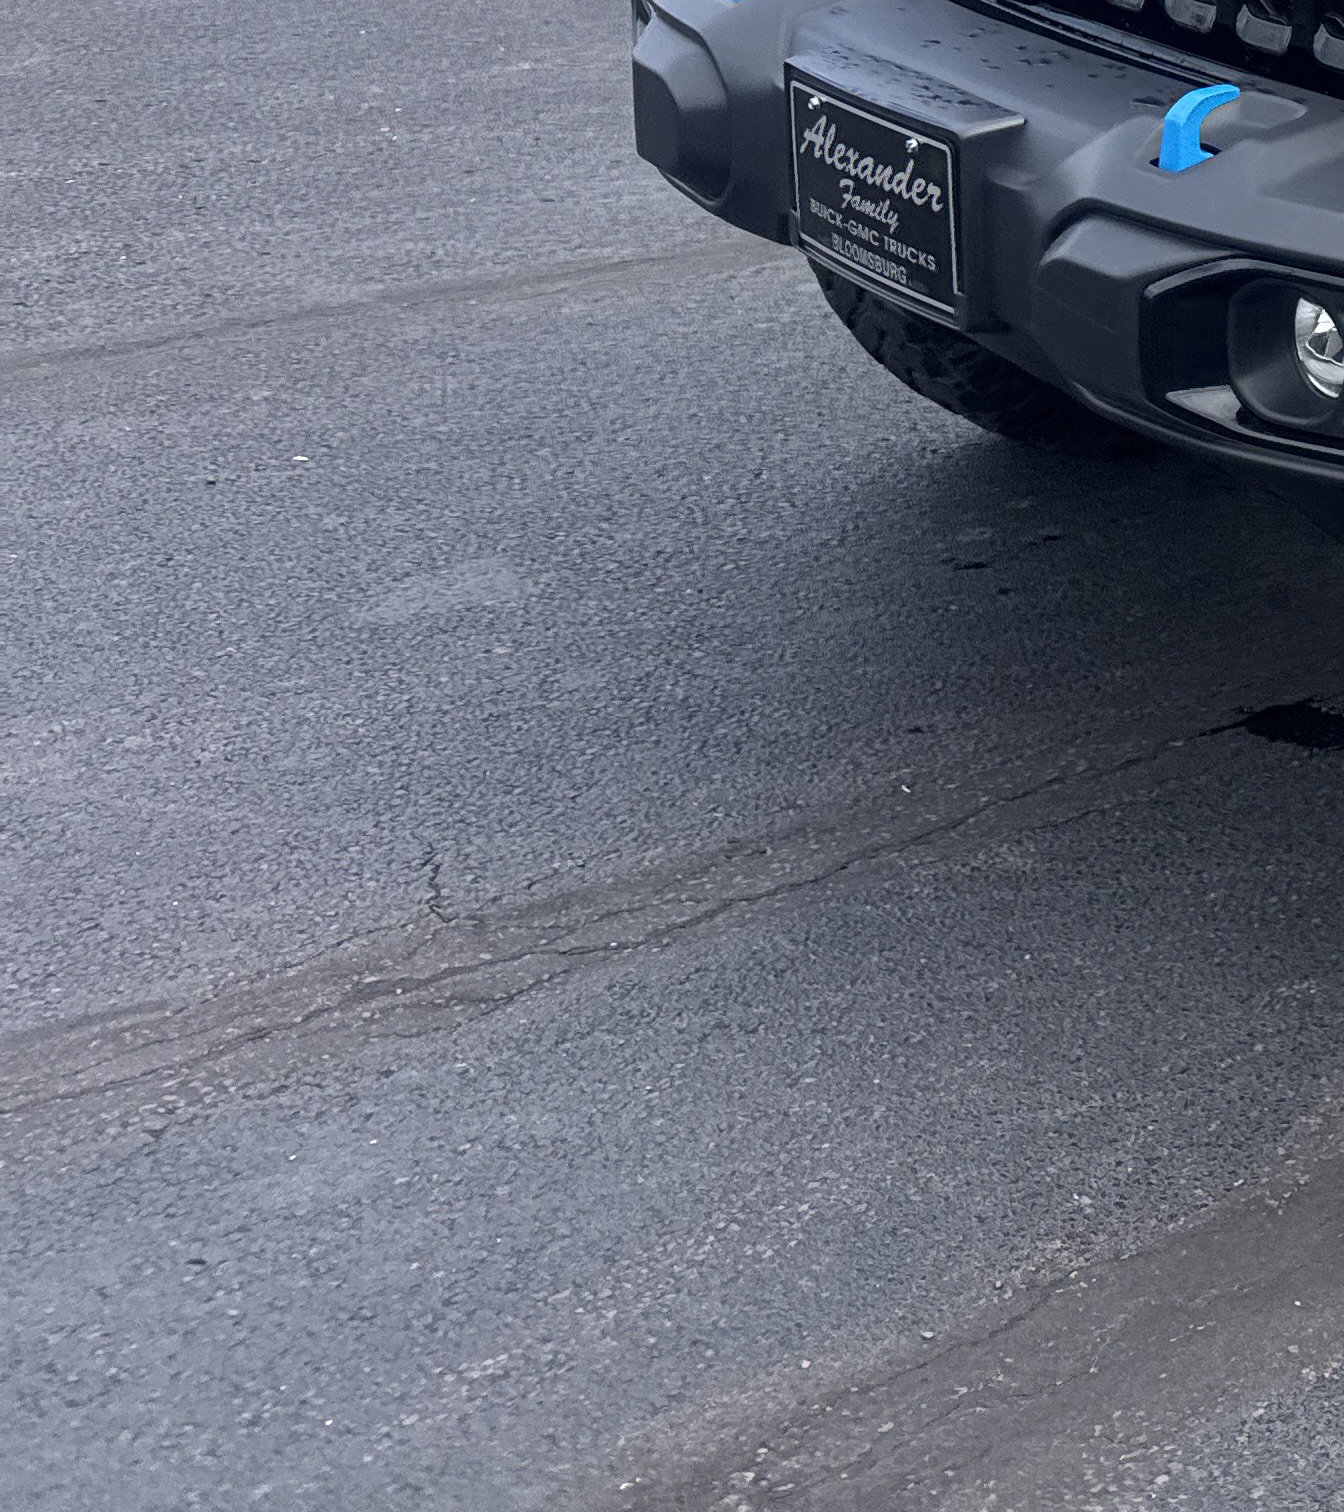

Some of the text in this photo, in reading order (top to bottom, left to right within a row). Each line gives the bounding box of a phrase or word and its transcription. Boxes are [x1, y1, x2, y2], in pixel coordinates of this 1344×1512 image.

[800, 115, 944, 213] Alexander
[839, 178, 900, 235] Family
[831, 232, 907, 285] BLOOMSBURG
[883, 235, 937, 272] TRUCKS
